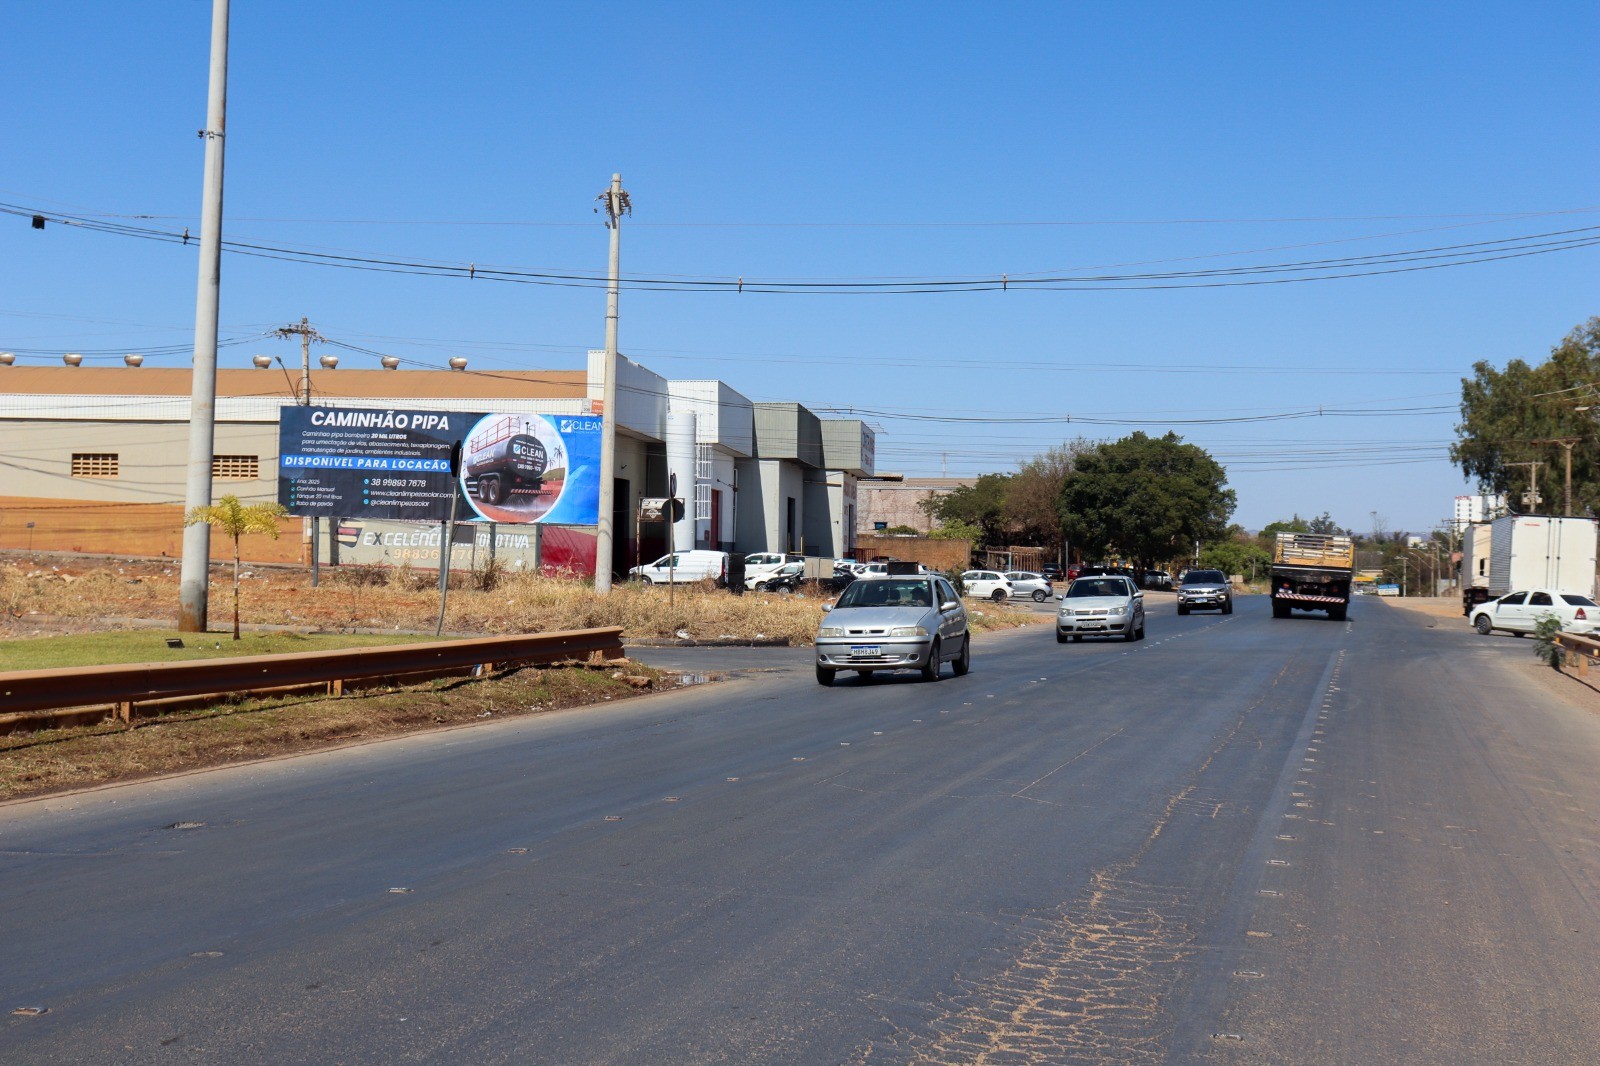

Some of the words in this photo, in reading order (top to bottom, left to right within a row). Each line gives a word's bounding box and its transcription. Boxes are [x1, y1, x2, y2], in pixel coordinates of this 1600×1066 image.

[310, 410, 409, 429] CAMINHÃO
[411, 414, 449, 431] PIPA
[521, 446, 544, 459] CLEAN
[285, 456, 353, 467] DISPONIVEL
[357, 459, 388, 468] PARA
[371, 478, 381, 487] 38
[394, 548, 440, 560] 98836
